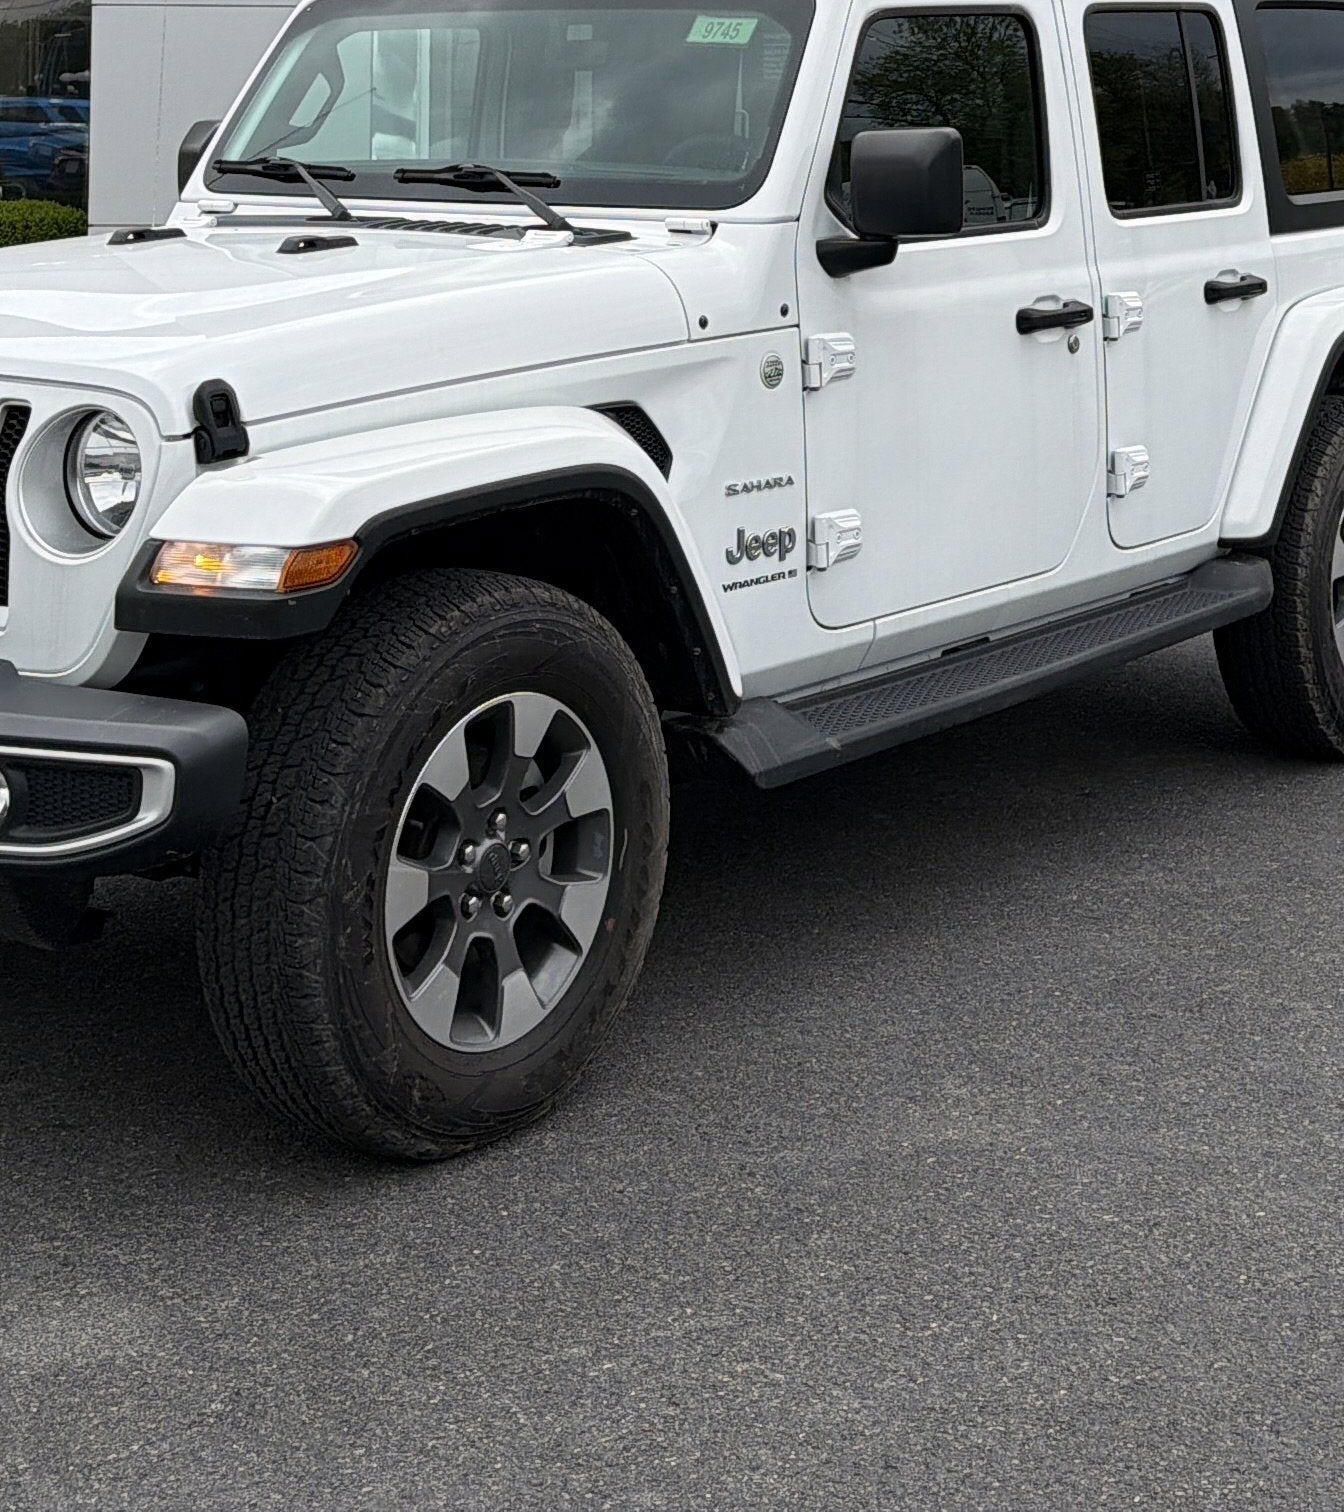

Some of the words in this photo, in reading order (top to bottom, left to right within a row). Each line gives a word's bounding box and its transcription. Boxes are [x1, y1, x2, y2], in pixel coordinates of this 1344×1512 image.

[702, 21, 743, 40] 9745
[725, 475, 795, 497] SAHARA
[725, 526, 796, 565] Jeep
[721, 571, 786, 593] WRANGLER
